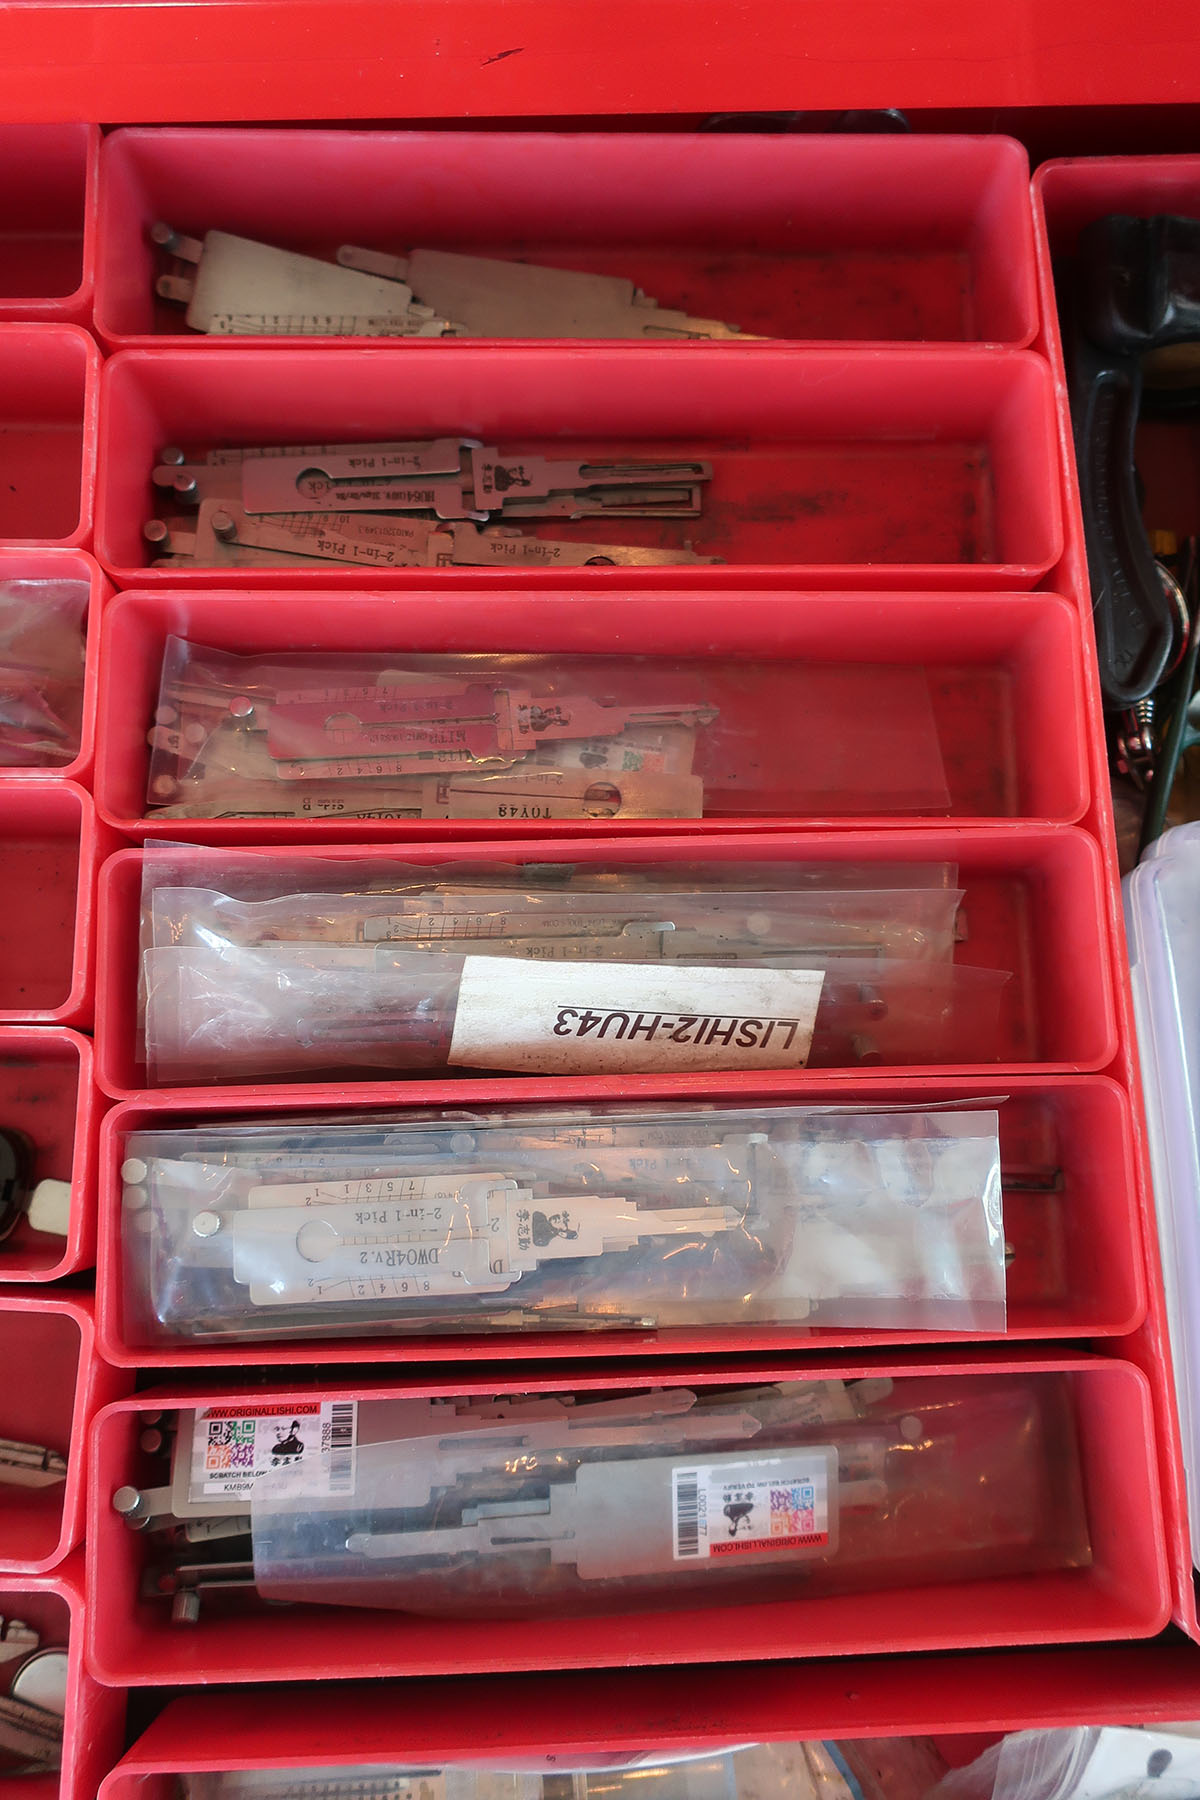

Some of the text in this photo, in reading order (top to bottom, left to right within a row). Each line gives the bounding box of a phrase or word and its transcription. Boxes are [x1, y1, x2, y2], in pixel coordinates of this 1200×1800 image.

[348, 457, 420, 469] 2-in-1 Pick
[308, 481, 332, 493] ick
[316, 539, 346, 557] Pick
[353, 546, 395, 562] 2-in-1
[490, 542, 560, 557] 2-in-1 Pick
[337, 768, 343, 776] 2
[428, 917, 435, 926] 2
[525, 946, 555, 958] Pick
[552, 1008, 799, 1050] LISHI2-HU43
[315, 1181, 415, 1197] 7 5 3 1 1
[305, 1197, 312, 1207] 2
[354, 1207, 442, 1224] 2-in-1 Pick
[307, 1278, 314, 1288] 2
[317, 1282, 430, 1295] 8 6 4 2 1
[209, 1471, 241, 1480] SCRATCH
[712, 1534, 823, 1553] WWW.ORIGINALLISHI.COM
